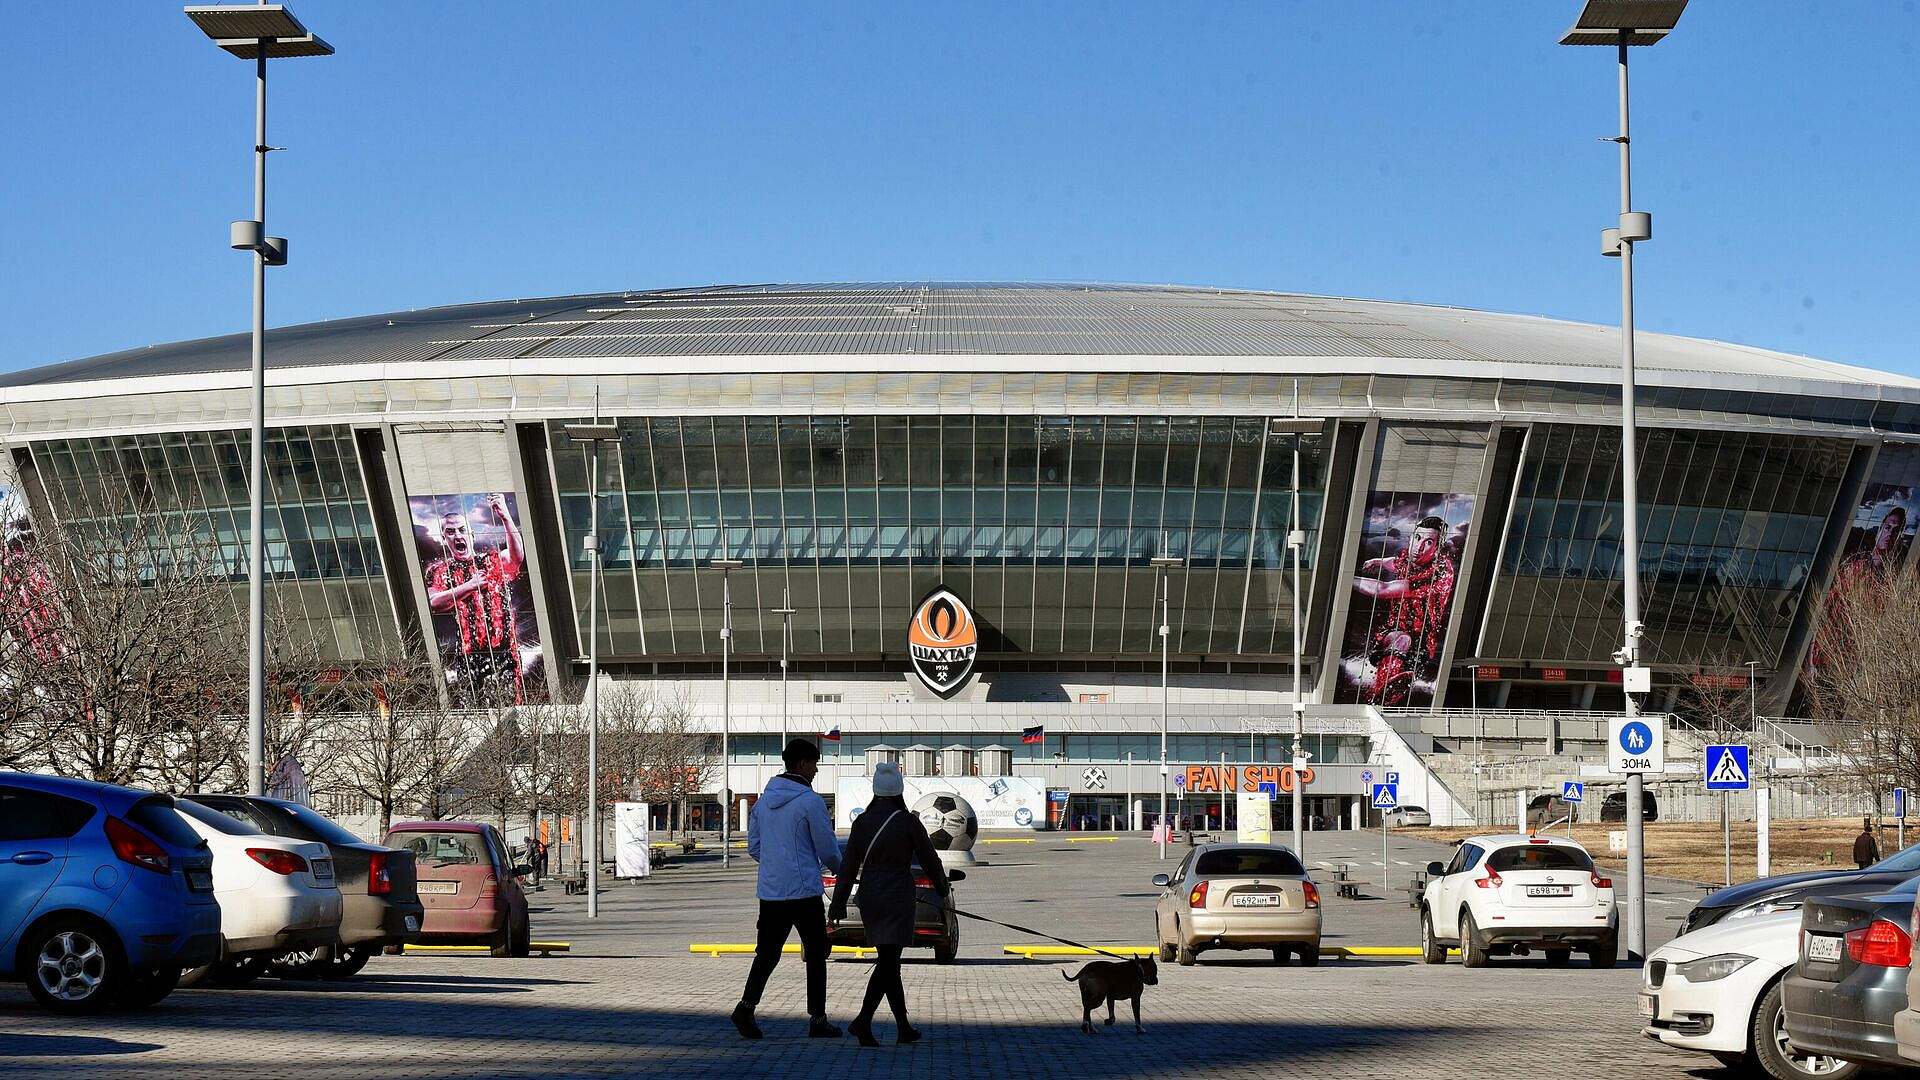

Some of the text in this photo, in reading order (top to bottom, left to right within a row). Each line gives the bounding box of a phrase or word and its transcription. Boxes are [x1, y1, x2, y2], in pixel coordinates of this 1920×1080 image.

[912, 645, 975, 661] ШАХТАР
[1621, 758, 1651, 769] ЗОНА
[1186, 766, 1316, 792] FAN SHOP
